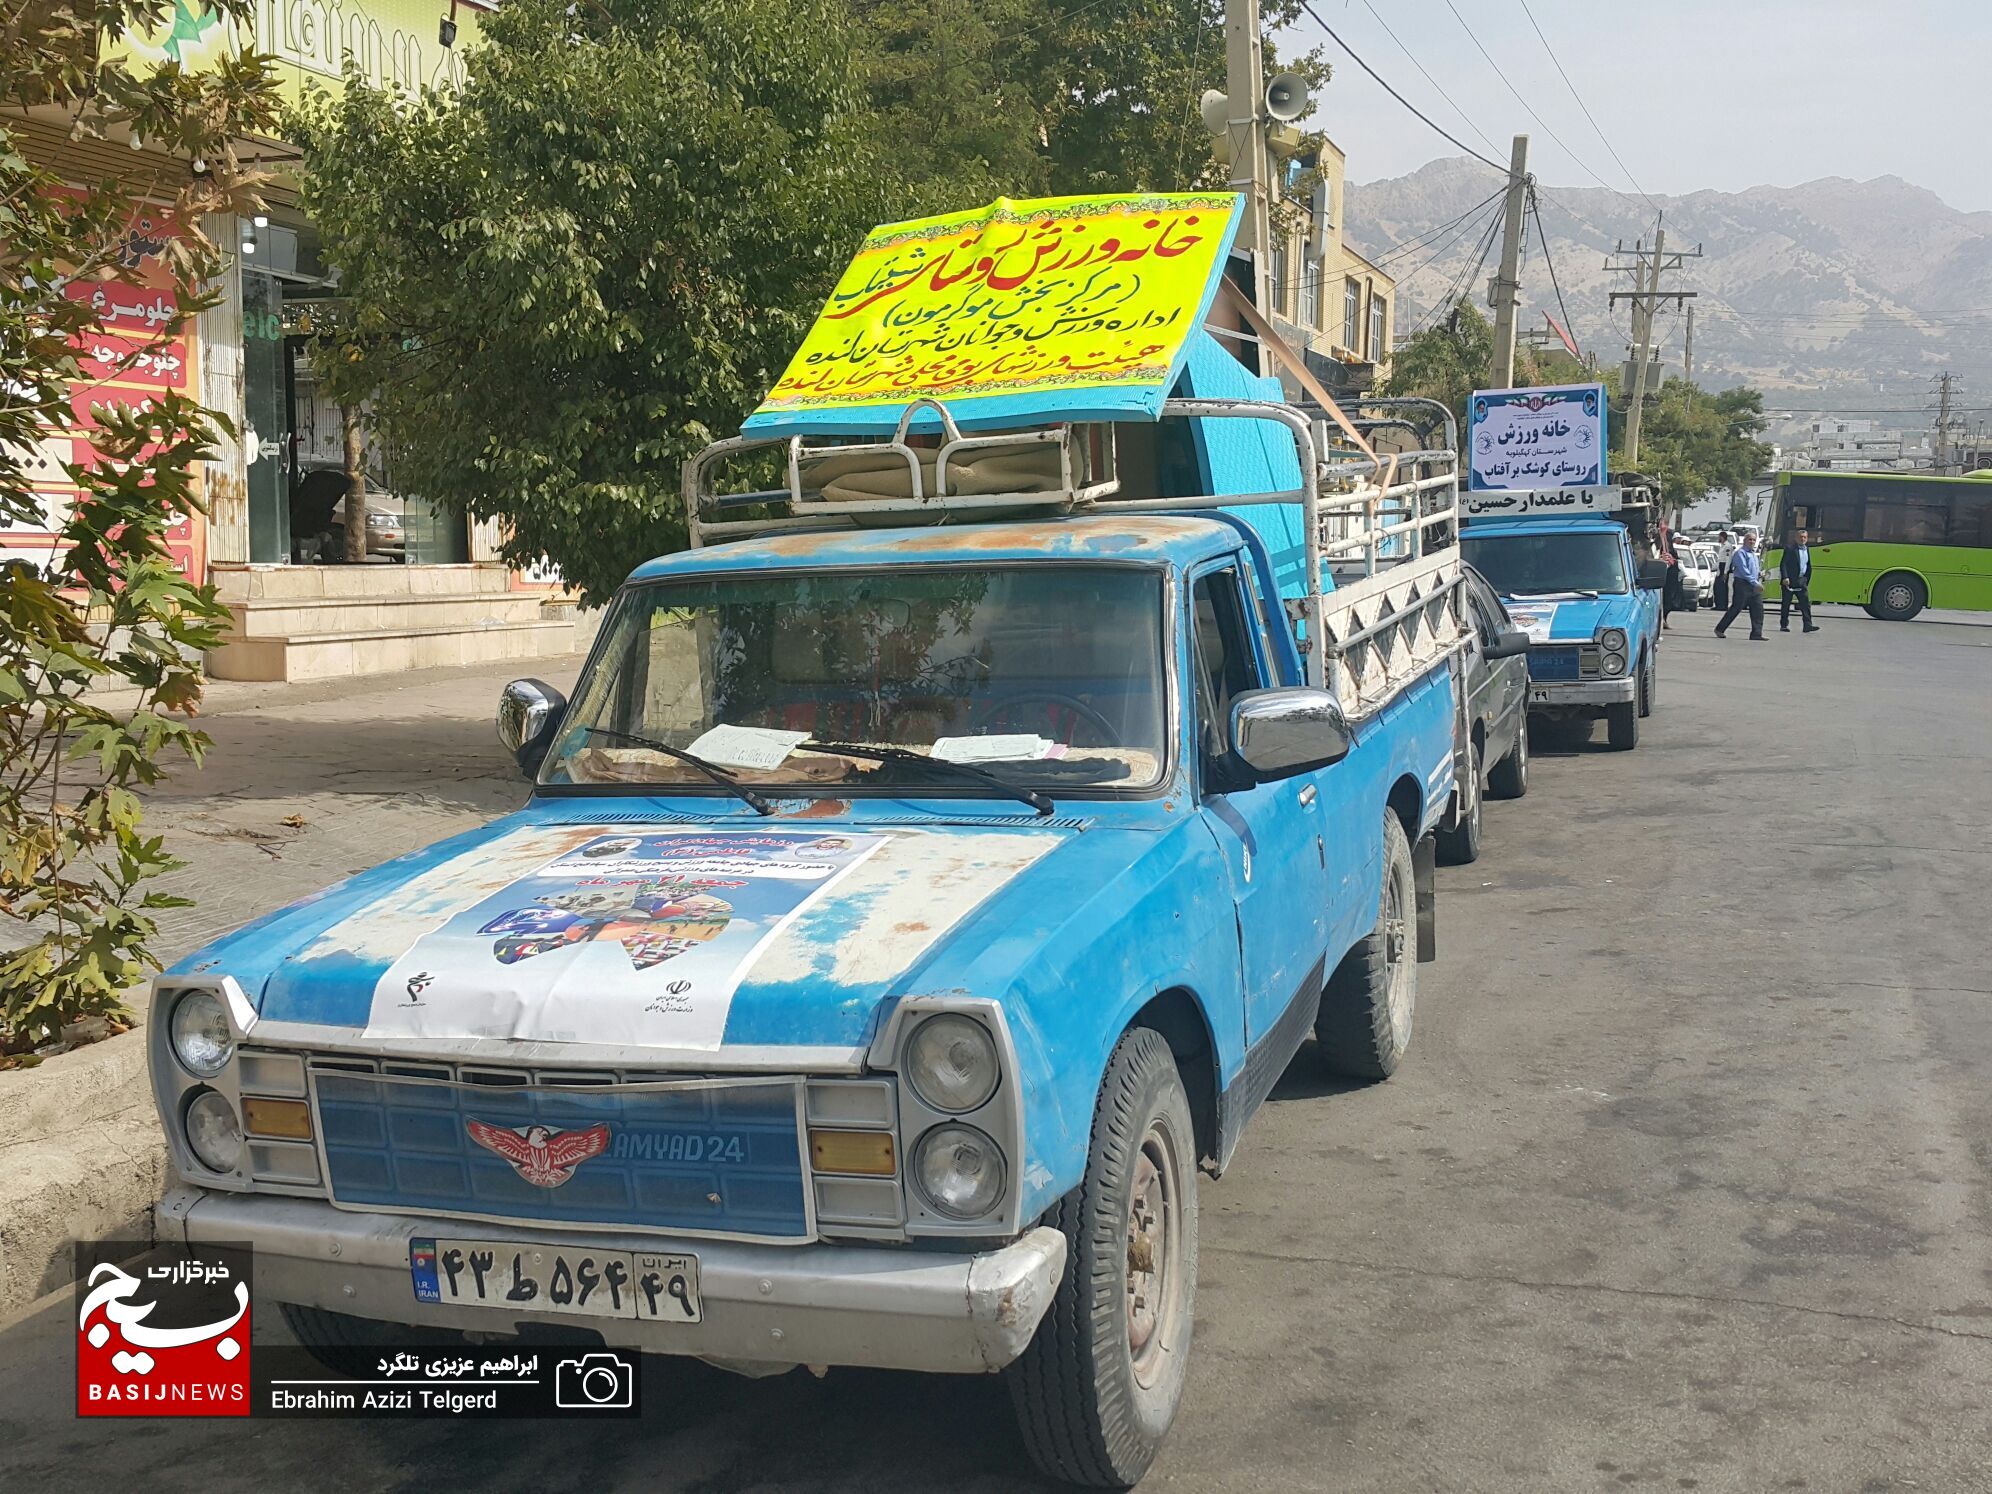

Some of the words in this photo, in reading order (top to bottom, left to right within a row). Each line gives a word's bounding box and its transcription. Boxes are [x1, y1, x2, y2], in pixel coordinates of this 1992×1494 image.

[1108, 215, 1203, 263] خانه
[987, 220, 1121, 290] ورزش
[822, 228, 1027, 319] روستای
[1054, 265, 1141, 308] (مرکز
[987, 278, 1067, 320] بخش
[1023, 305, 1119, 342] ورزش
[1105, 307, 1182, 333] اداره
[805, 330, 865, 365] لنده
[848, 323, 951, 363] شهرستان
[934, 320, 1021, 352] جوانان
[1001, 328, 1024, 343] و
[1066, 340, 1166, 370] هیئت
[778, 367, 834, 390] لنده
[814, 354, 915, 392] شهرستان
[892, 354, 957, 386] محلی
[932, 358, 984, 385] بومی
[1497, 422, 1539, 445] ورزش
[1542, 418, 1571, 437] خانه
[1505, 448, 1532, 458] کهگیلویه
[1531, 446, 1568, 457] شهرستان
[1521, 461, 1551, 478] کوشک
[1552, 460, 1587, 477] روستای
[1468, 493, 1517, 513] حسین
[1518, 490, 1576, 512] علمدار
[1580, 489, 1594, 508] یا
[603, 1132, 704, 1161] AMYAD
[707, 1136, 745, 1162] 24
[642, 1257, 688, 1270] ایران
[418, 1289, 440, 1299] IRAN
[441, 1249, 494, 1299] ۴۳
[506, 1252, 539, 1301] ط
[549, 1255, 628, 1311] ۵۶۴
[640, 1272, 696, 1317] ۴۹
